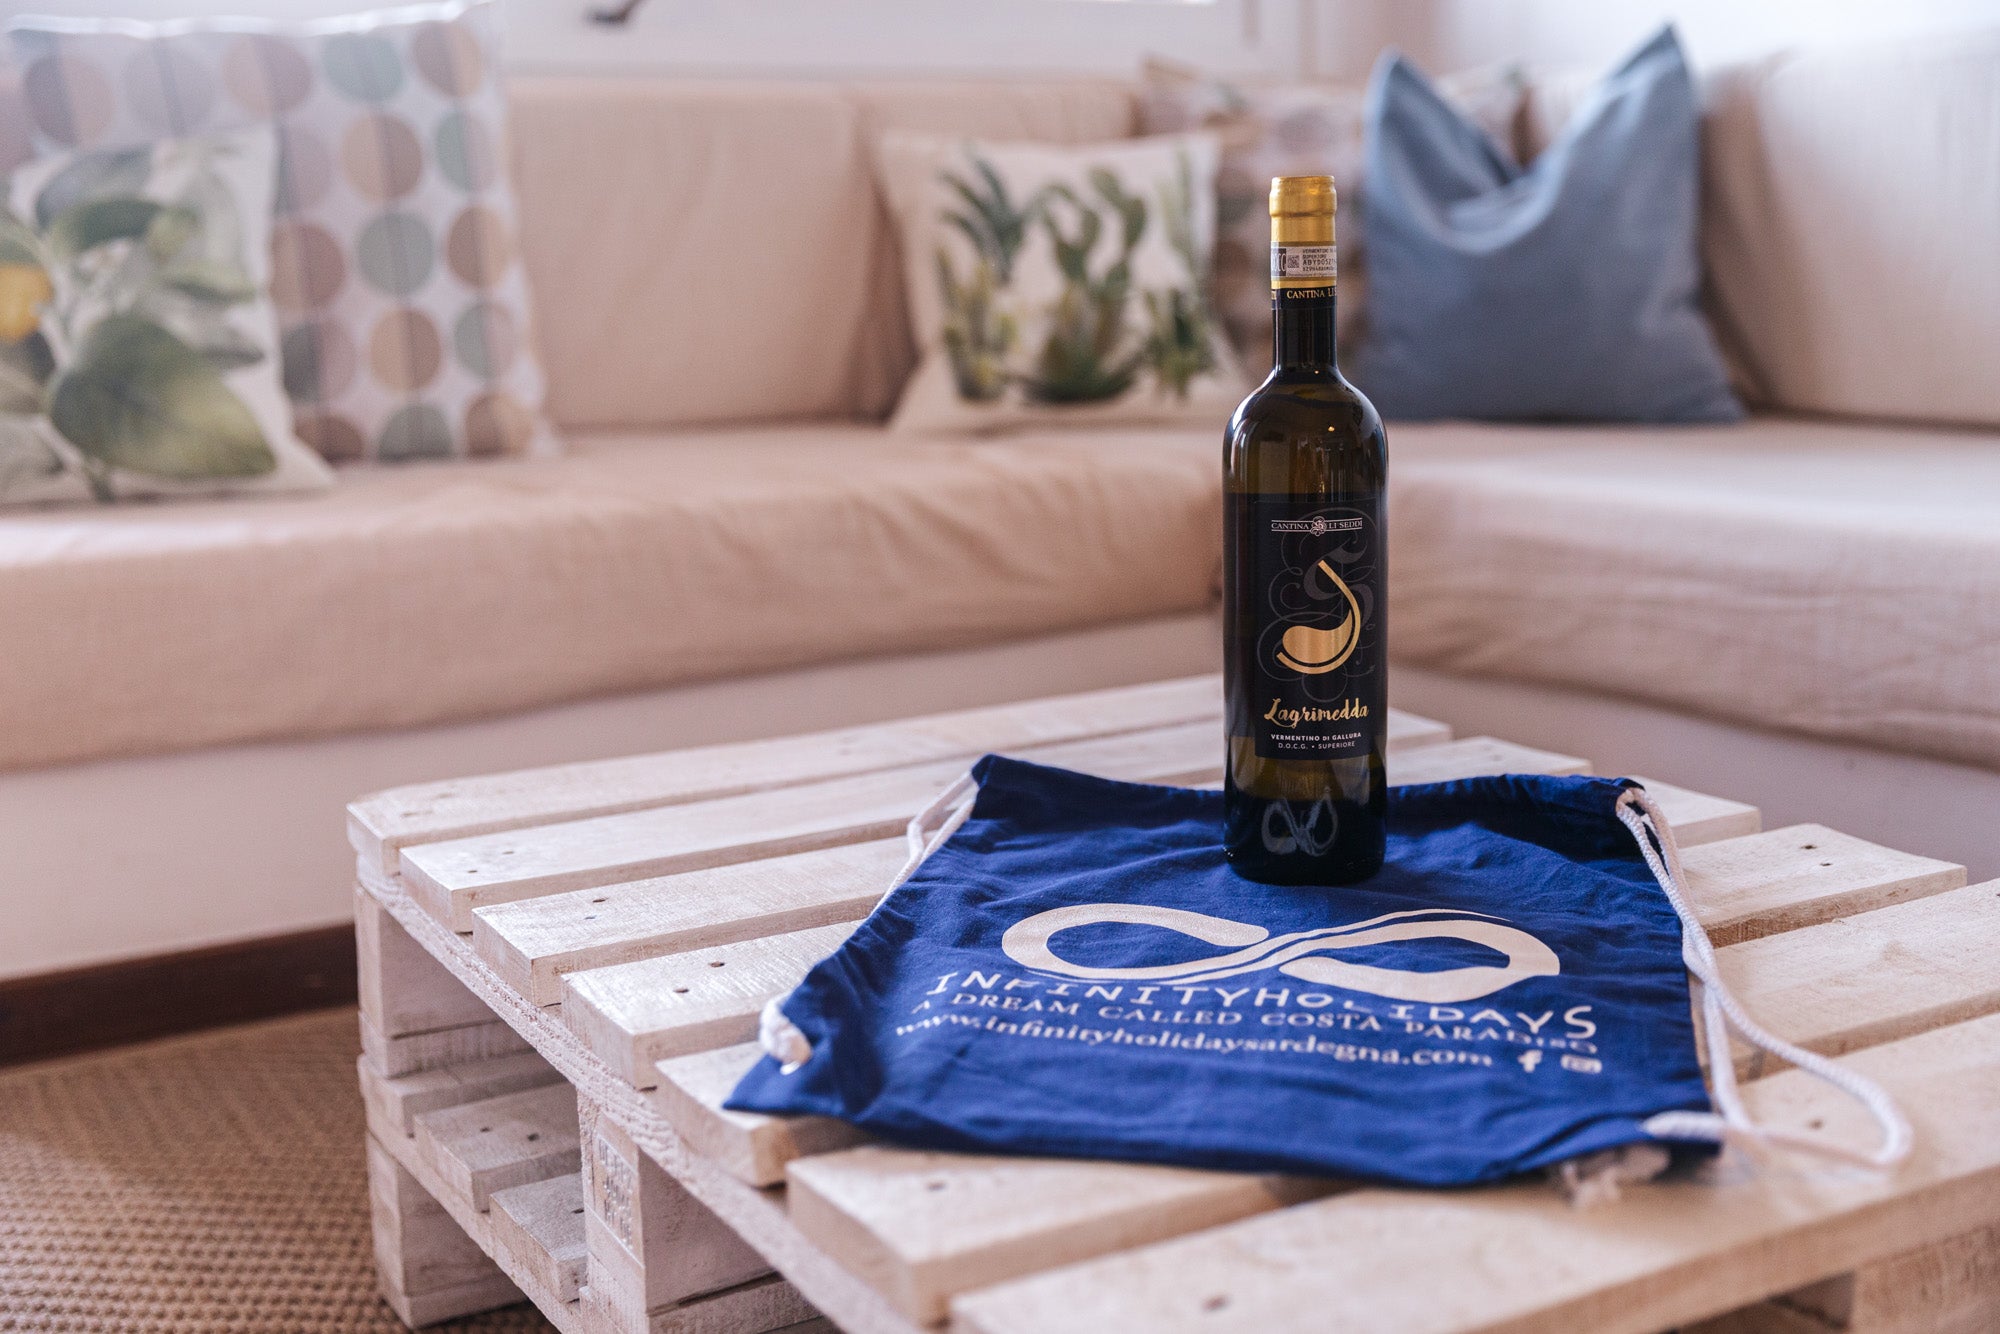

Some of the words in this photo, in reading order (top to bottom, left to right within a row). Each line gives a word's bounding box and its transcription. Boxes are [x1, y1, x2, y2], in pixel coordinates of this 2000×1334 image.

[1286, 289, 1325, 299] CANTINA
[1271, 522, 1309, 530] CANTINA
[1328, 521, 1337, 529] LI
[1339, 519, 1363, 529] SEDDI
[1263, 697, 1369, 729] Lagrimedda
[1270, 733, 1320, 742] VERMENTINO
[1331, 732, 1362, 740] GALLURA
[1278, 742, 1308, 750] D.O.C.G.
[1318, 740, 1355, 750] SUPERIORE
[951, 992, 1081, 1016] DREAM
[1098, 1005, 1243, 1026] CALLED
[1260, 1011, 1383, 1032] COSTA
